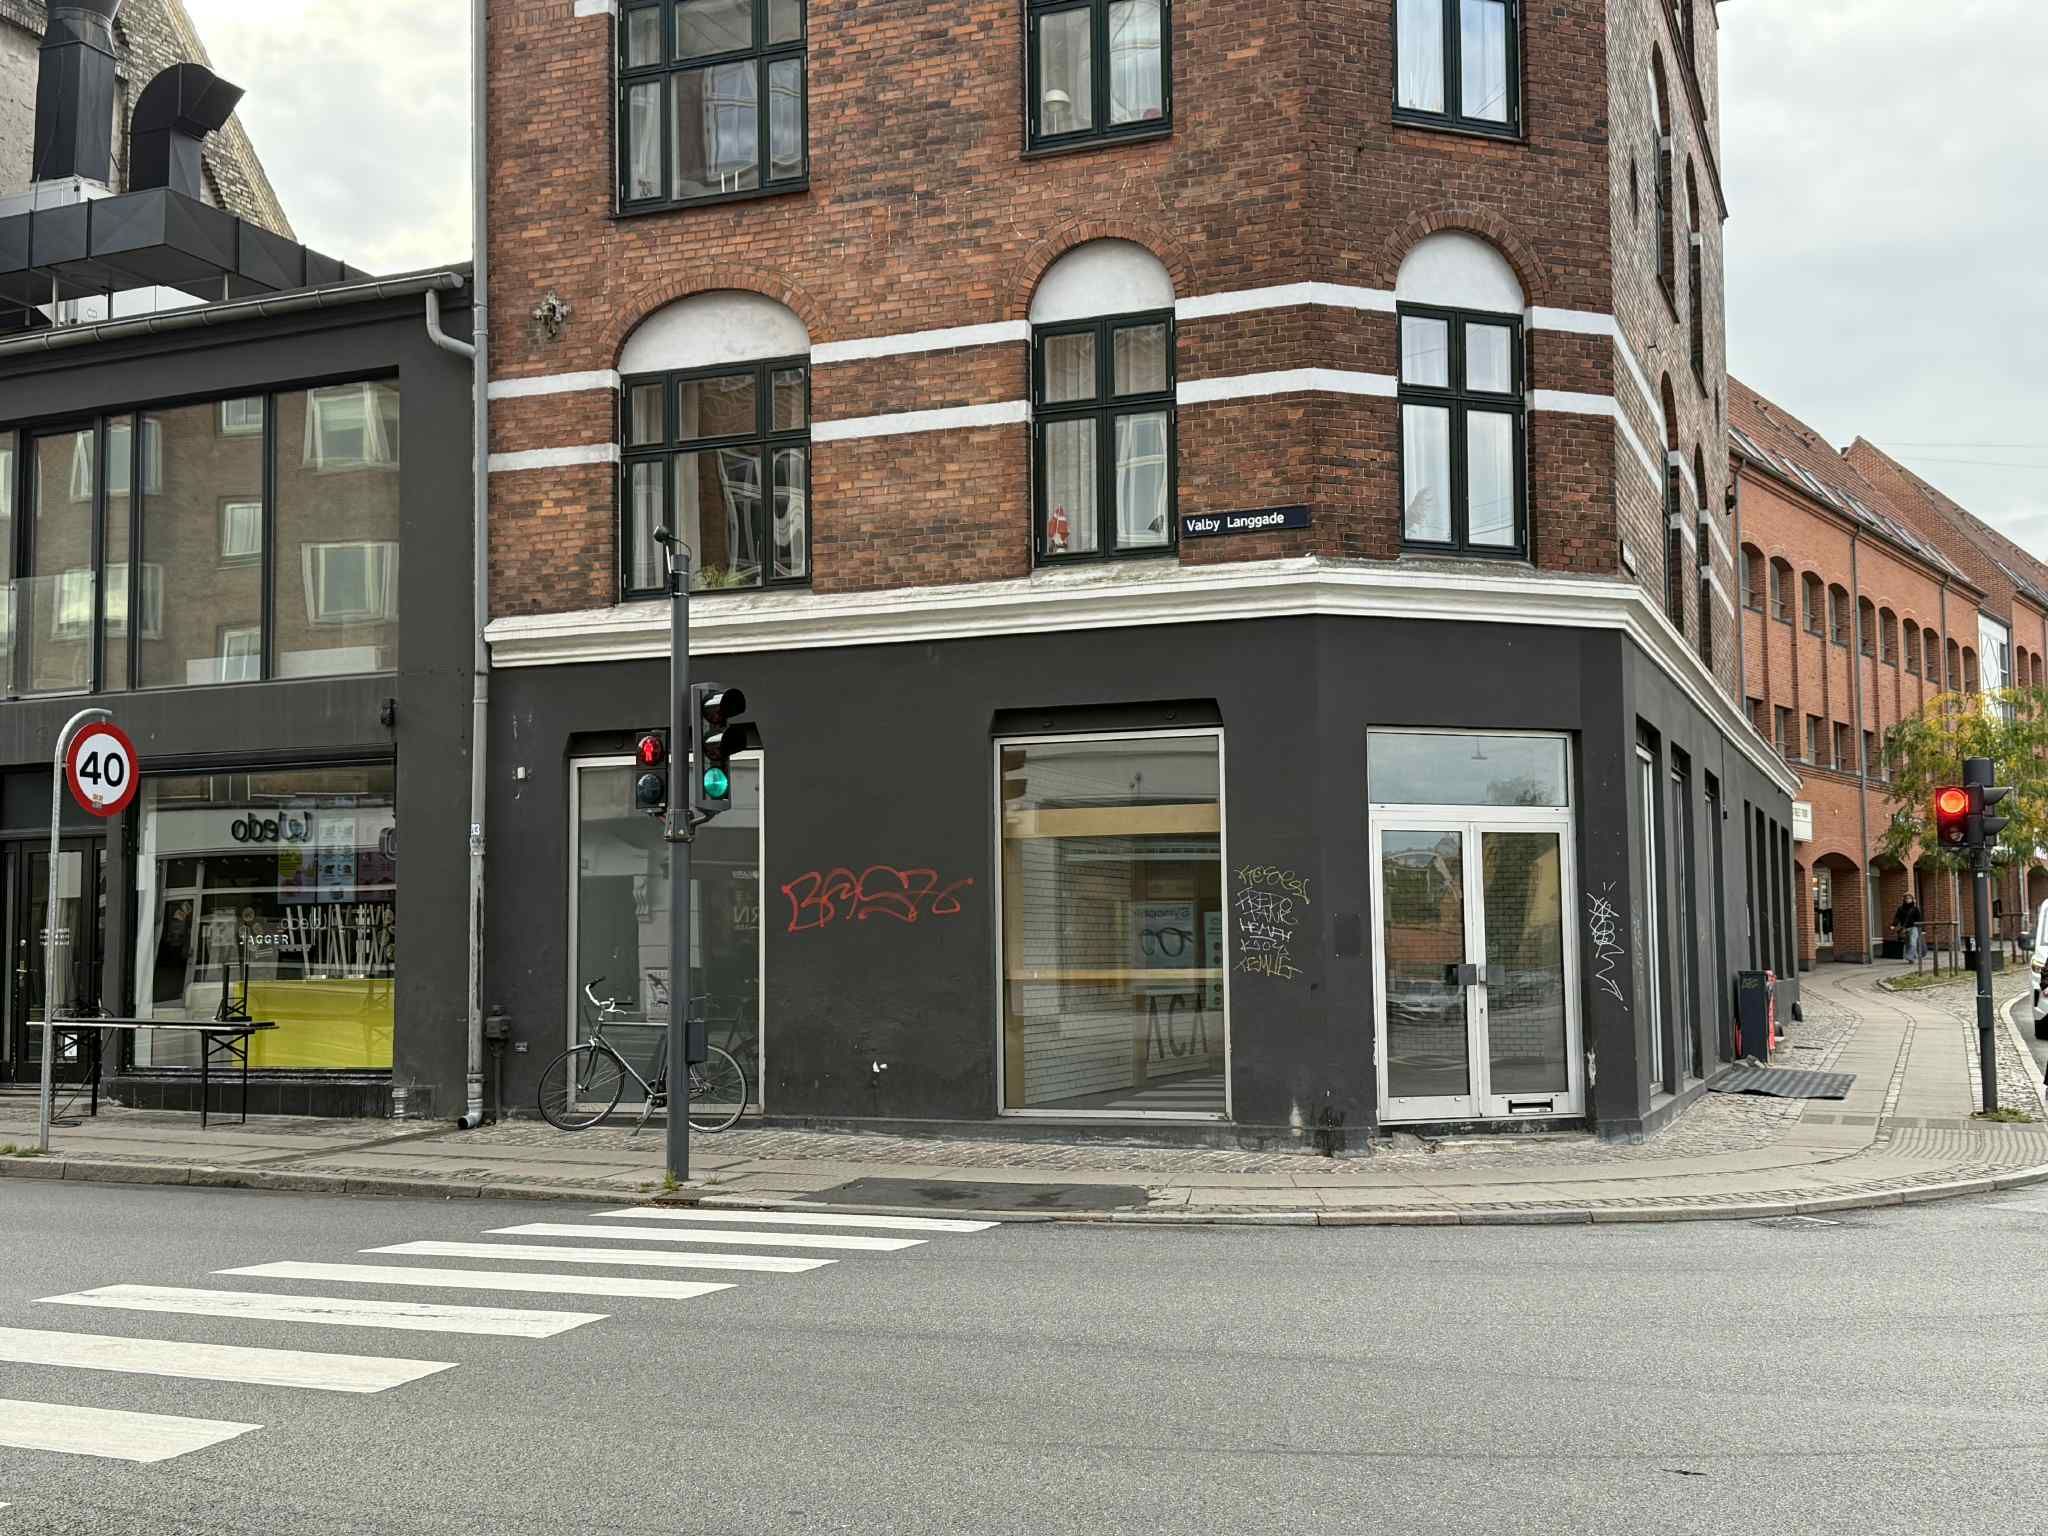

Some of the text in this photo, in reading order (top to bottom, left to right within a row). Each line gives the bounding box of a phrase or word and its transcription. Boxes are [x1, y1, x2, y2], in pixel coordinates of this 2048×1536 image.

[1187, 512, 1284, 532] Valby Langgade
[79, 751, 125, 787] 40
